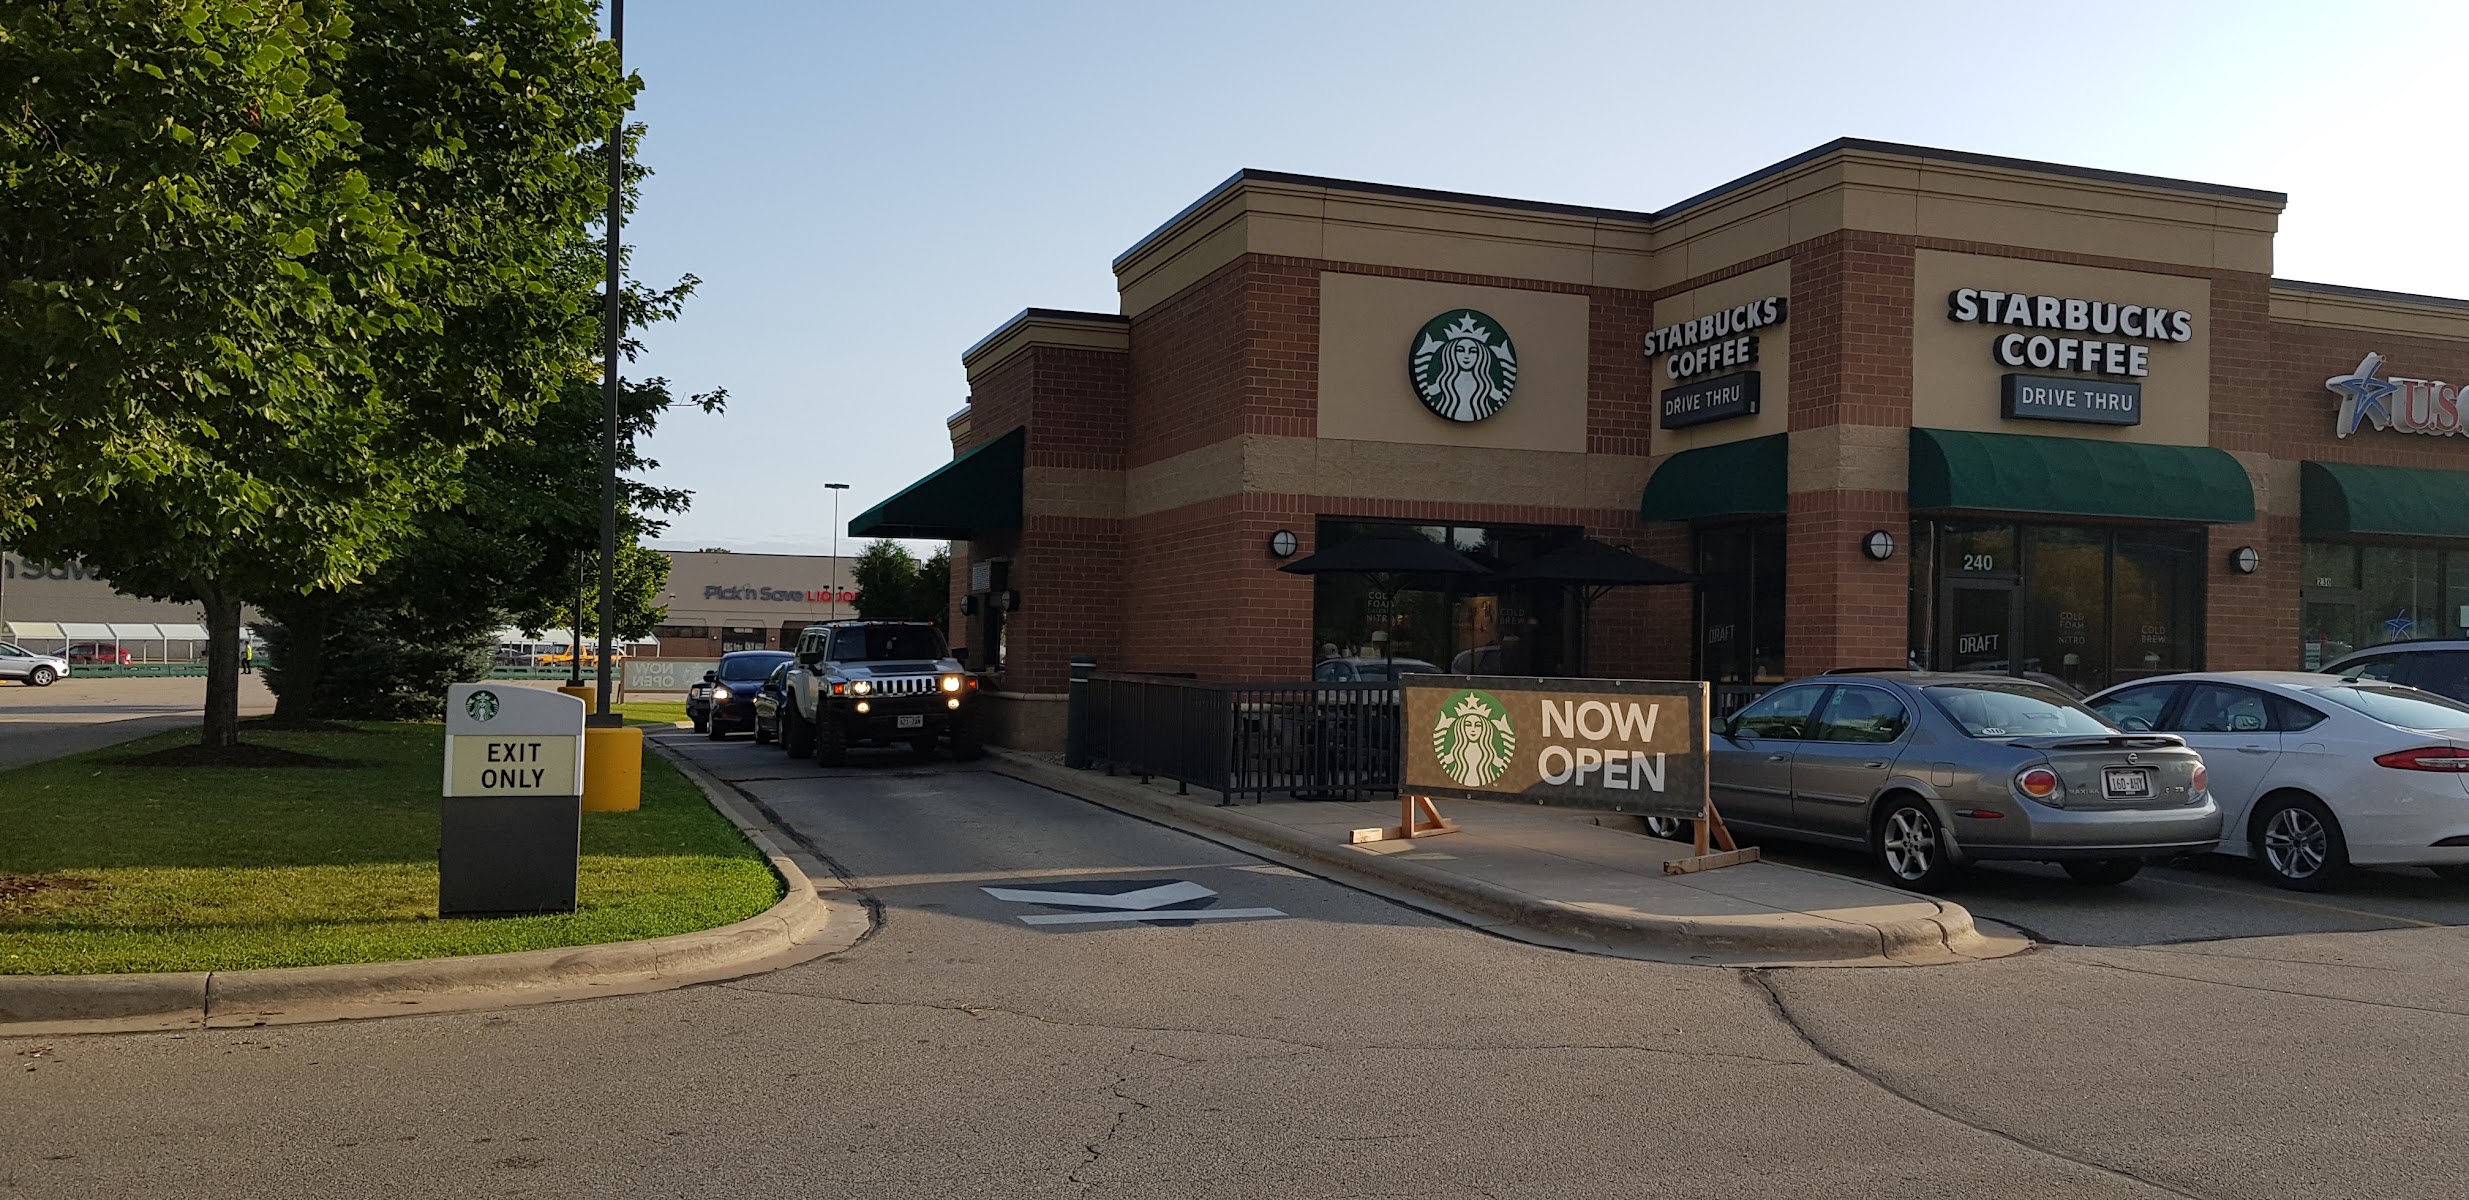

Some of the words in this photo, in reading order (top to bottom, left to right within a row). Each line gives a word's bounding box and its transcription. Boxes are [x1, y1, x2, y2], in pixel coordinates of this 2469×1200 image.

[1955, 288, 2192, 342] STARBUCKS
[1644, 296, 1779, 357] STARBUCKS
[1666, 336, 1750, 379] COFFEE
[2001, 333, 2149, 377] COFFEE
[1665, 394, 1701, 416] DRIVE
[1705, 385, 1740, 408] THRU
[2022, 386, 2077, 408] DRIVE
[2084, 391, 2133, 411] THRU
[2402, 381, 2463, 432] U.S.
[1963, 554, 1993, 571] 240
[760, 586, 804, 602] Save
[1368, 591, 1388, 600] COL
[1500, 608, 1525, 617] COLD
[1500, 616, 1525, 625] BREW
[2059, 611, 2085, 620] COLD
[1708, 625, 1735, 644] DRAFT
[2059, 620, 2085, 629] FOAM
[2141, 625, 2166, 634] COLD
[1960, 634, 1999, 654] DRAFT
[2058, 636, 2086, 645] NITRO
[2141, 634, 2166, 643] BREW
[1541, 699, 1660, 743] NOW
[487, 743, 542, 763] EXIT
[481, 768, 545, 789] ONLY
[1538, 745, 1666, 793] OPEN
